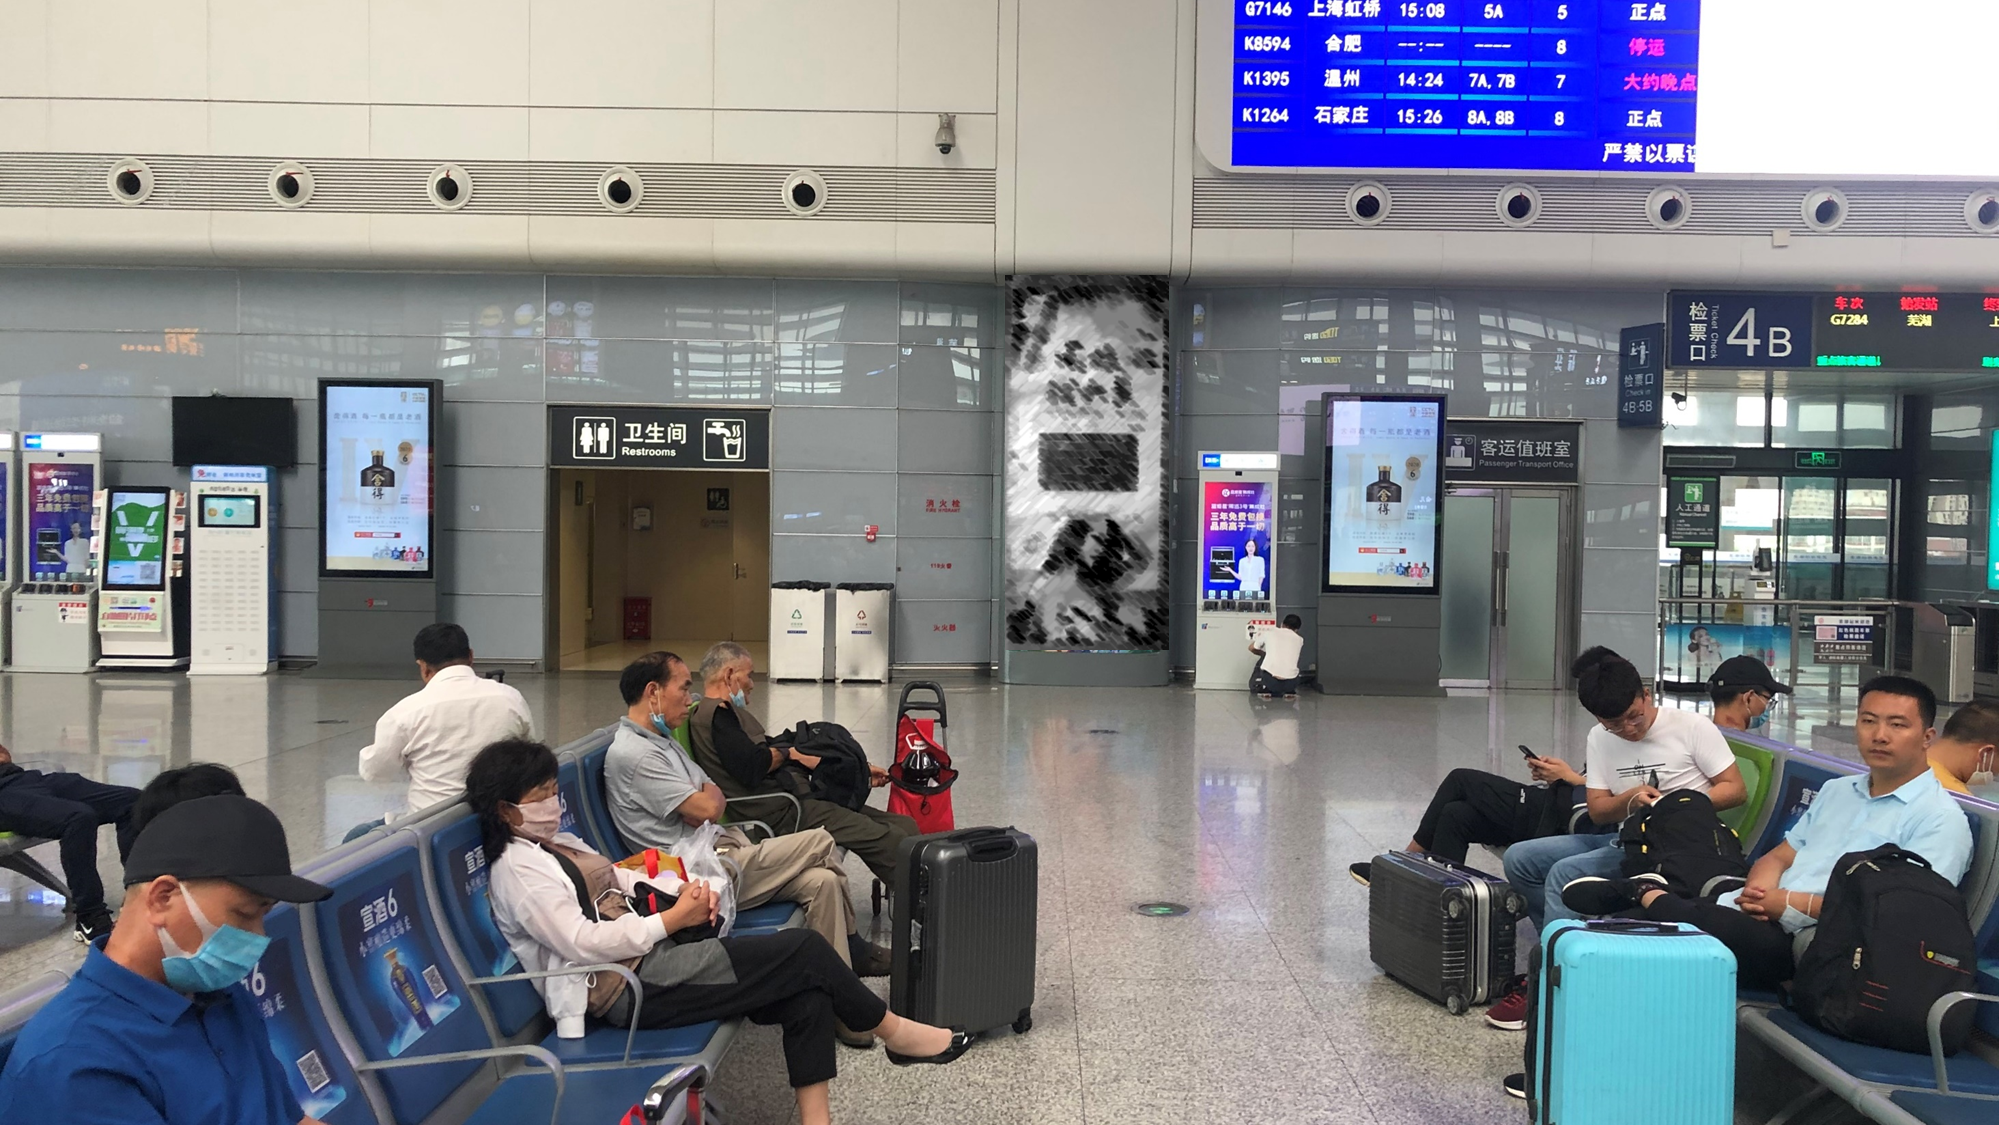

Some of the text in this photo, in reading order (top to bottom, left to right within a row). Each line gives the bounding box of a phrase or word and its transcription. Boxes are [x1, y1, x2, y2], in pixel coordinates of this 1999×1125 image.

[1245, 0, 1667, 21] G7146 上海虹桥 15:08 5A 5 正点
[1244, 36, 1291, 51] K8594
[1324, 34, 1362, 53] 合肥
[1556, 39, 1567, 55] 8
[1628, 37, 1666, 57] 停运
[1243, 71, 1290, 87] K1395
[1323, 69, 1360, 88] 温州
[1398, 72, 1444, 88] 14:24
[1555, 75, 1566, 89] 7
[1623, 72, 1697, 92] 大约晚点
[1242, 108, 1289, 123] K1264
[1314, 105, 1369, 124] 石家庄
[1397, 109, 1443, 125] 15:26
[1554, 111, 1565, 126] 8
[1626, 109, 1663, 128] 正点
[1835, 296, 1864, 310] 车次
[1900, 297, 1939, 311] 始发站
[1830, 314, 1869, 326] G7284
[1907, 314, 1932, 327] 芜湖
[1689, 302, 1708, 361] 检票口
[1710, 304, 1719, 359] Ticket Check
[1624, 373, 1654, 388] 检票口
[1625, 389, 1644, 398] Check
[622, 422, 687, 444] 卫生间
[622, 447, 676, 456] Restrooms
[1480, 439, 1571, 457] 客运值班室
[1480, 460, 1517, 468] Passenger
[1518, 460, 1551, 469] Transport
[926, 499, 960, 508] 消火栓
[1377, 488, 1392, 515] 舍得
[1675, 504, 1710, 512] 人工通道
[1210, 521, 1265, 531] 品质高于一切
